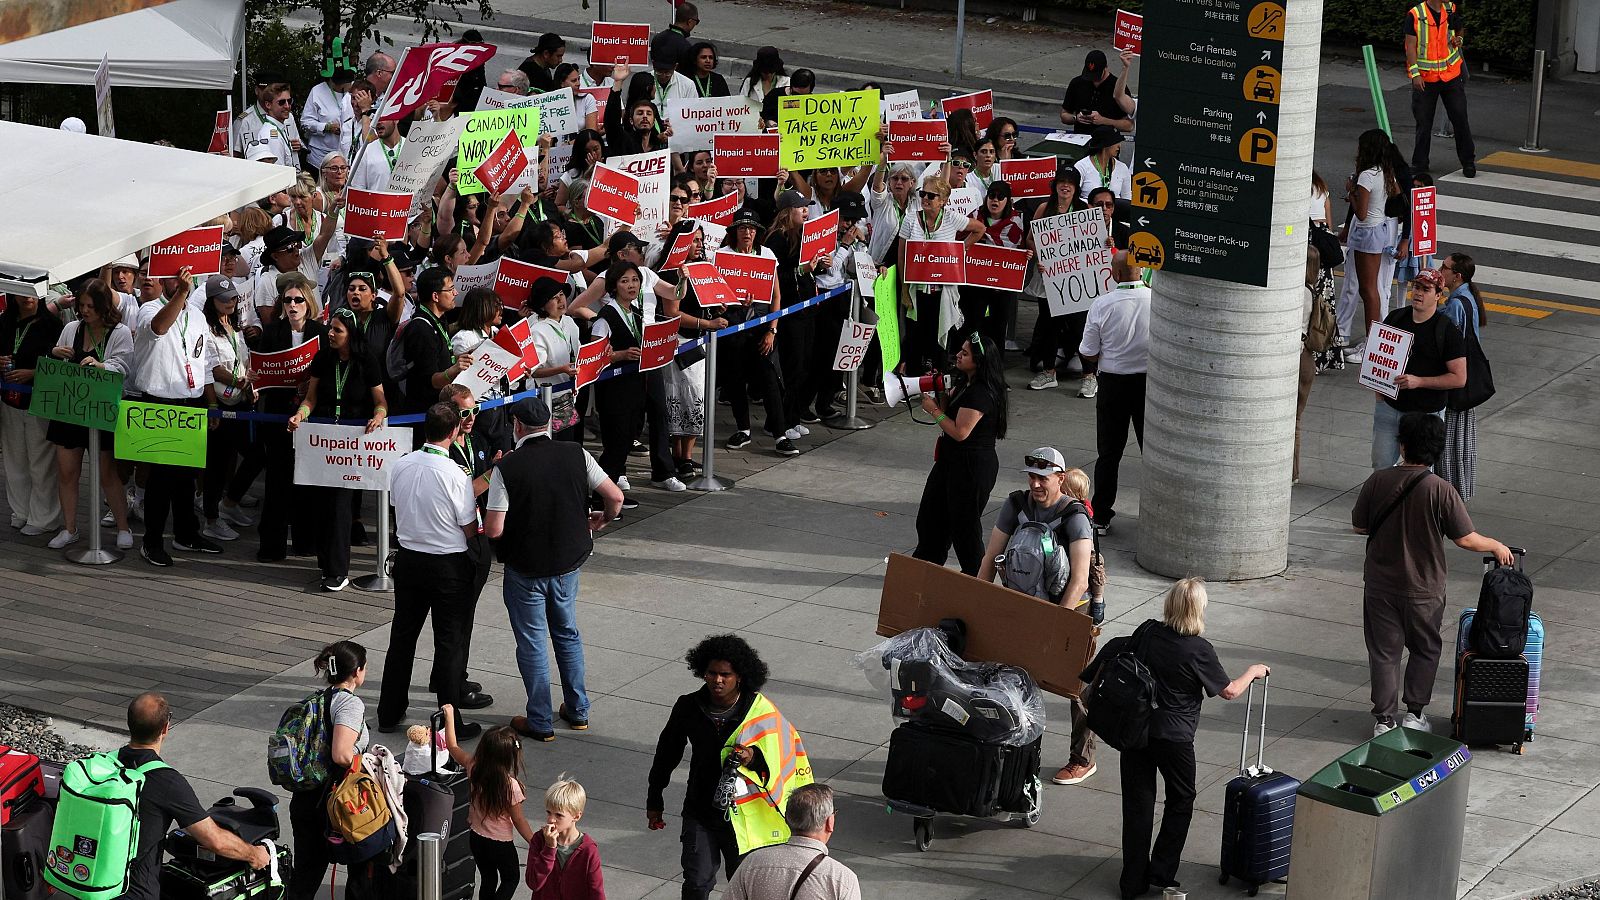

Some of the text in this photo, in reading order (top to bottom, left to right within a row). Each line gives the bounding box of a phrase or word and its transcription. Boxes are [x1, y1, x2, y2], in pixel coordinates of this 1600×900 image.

[1224, 2, 1240, 10] ville
[1131, 24, 1142, 33] pay
[593, 36, 620, 45] Unpaid
[629, 38, 649, 46] Unfair
[1190, 42, 1237, 57] Car Rentals
[1158, 50, 1236, 69] Voitures de location
[549, 106, 571, 118] FREE
[681, 104, 751, 120] Unpaid work
[805, 95, 862, 115] DON'T
[889, 101, 909, 112] Unpaid
[971, 103, 993, 114] Canada
[1203, 107, 1233, 121] Parking
[465, 113, 527, 133] CANADIAN
[695, 119, 741, 132] won't fly
[784, 116, 867, 134] TAKE AWAY
[1173, 114, 1232, 131] Stationnement
[800, 132, 860, 147] MY RIGHT
[890, 134, 917, 143] Unpaid
[925, 133, 948, 142] Unfair
[715, 148, 744, 158] Unpaid
[754, 148, 779, 156] Unfair
[816, 138, 871, 160] STRIKE!!
[487, 164, 502, 178] Non
[627, 155, 667, 174] CUPE
[1001, 169, 1057, 182] UnfAir Canada
[1178, 163, 1255, 182] Animal Relief Area
[593, 180, 618, 195] Unpaid
[1178, 176, 1239, 193] Lieu d'aisance
[953, 196, 972, 205] work
[1177, 187, 1235, 202] pour animaux
[347, 203, 379, 217] Unpaid
[390, 208, 410, 218] Unfair
[714, 205, 738, 219] Canada
[1031, 208, 1102, 235] MIKE CHEQUE
[803, 231, 821, 243] UnfAir
[1175, 228, 1250, 249] Passenger Pick-up
[152, 242, 221, 255] UnfAir Canada
[1040, 236, 1102, 262] AIR CANADA
[913, 254, 959, 264] Air Canular
[966, 256, 992, 267] Unpaid
[1002, 260, 1026, 271] Unfair
[1045, 250, 1109, 278] WHERE ARE
[456, 275, 483, 283] Poverty
[497, 273, 529, 289] Unpaid
[692, 276, 714, 286] Unpaid
[750, 270, 774, 280] Unfair
[1053, 268, 1112, 305] YOU?
[643, 338, 662, 349] Unpaid
[1378, 328, 1404, 344] FIGHT
[1378, 342, 1395, 356] FOR
[284, 354, 304, 368] payé
[577, 352, 601, 366] Unpaid
[1368, 352, 1399, 370] HIGHER
[38, 361, 118, 383] NO CONTRACT
[1371, 366, 1391, 381] PAY!
[62, 381, 90, 398] NO
[40, 390, 118, 423] FLIGHTS
[126, 406, 206, 430] RESPECT
[309, 434, 397, 452] Unpaid work
[325, 454, 384, 470] won't fly
